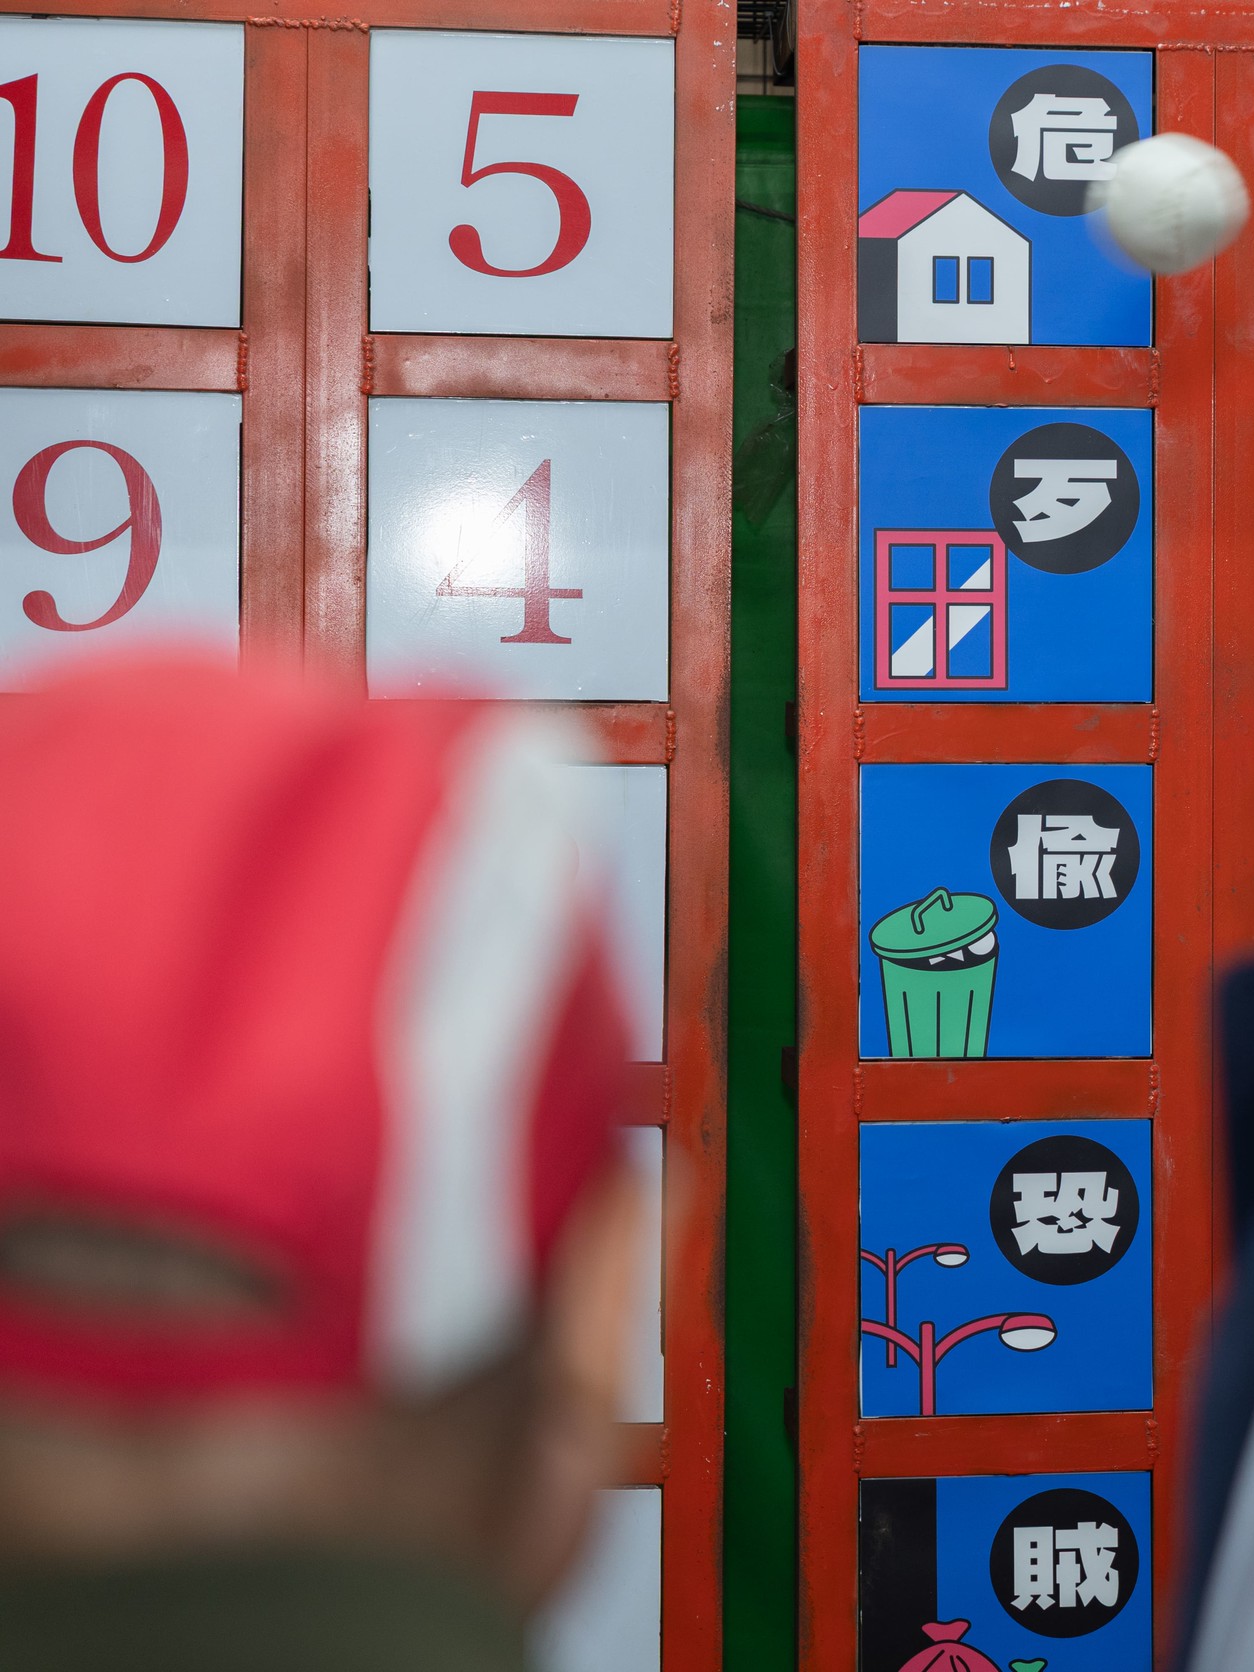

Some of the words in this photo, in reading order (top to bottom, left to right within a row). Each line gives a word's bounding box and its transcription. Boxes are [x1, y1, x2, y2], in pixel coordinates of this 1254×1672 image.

[0, 72, 189, 263] 10
[448, 90, 592, 278] 5
[1010, 93, 1118, 182] 危
[12, 439, 163, 633] 9
[435, 458, 584, 645] 4
[1012, 458, 1118, 543] 歹
[1011, 1171, 1121, 1256] 恐
[1010, 1521, 1120, 1612] 賊
